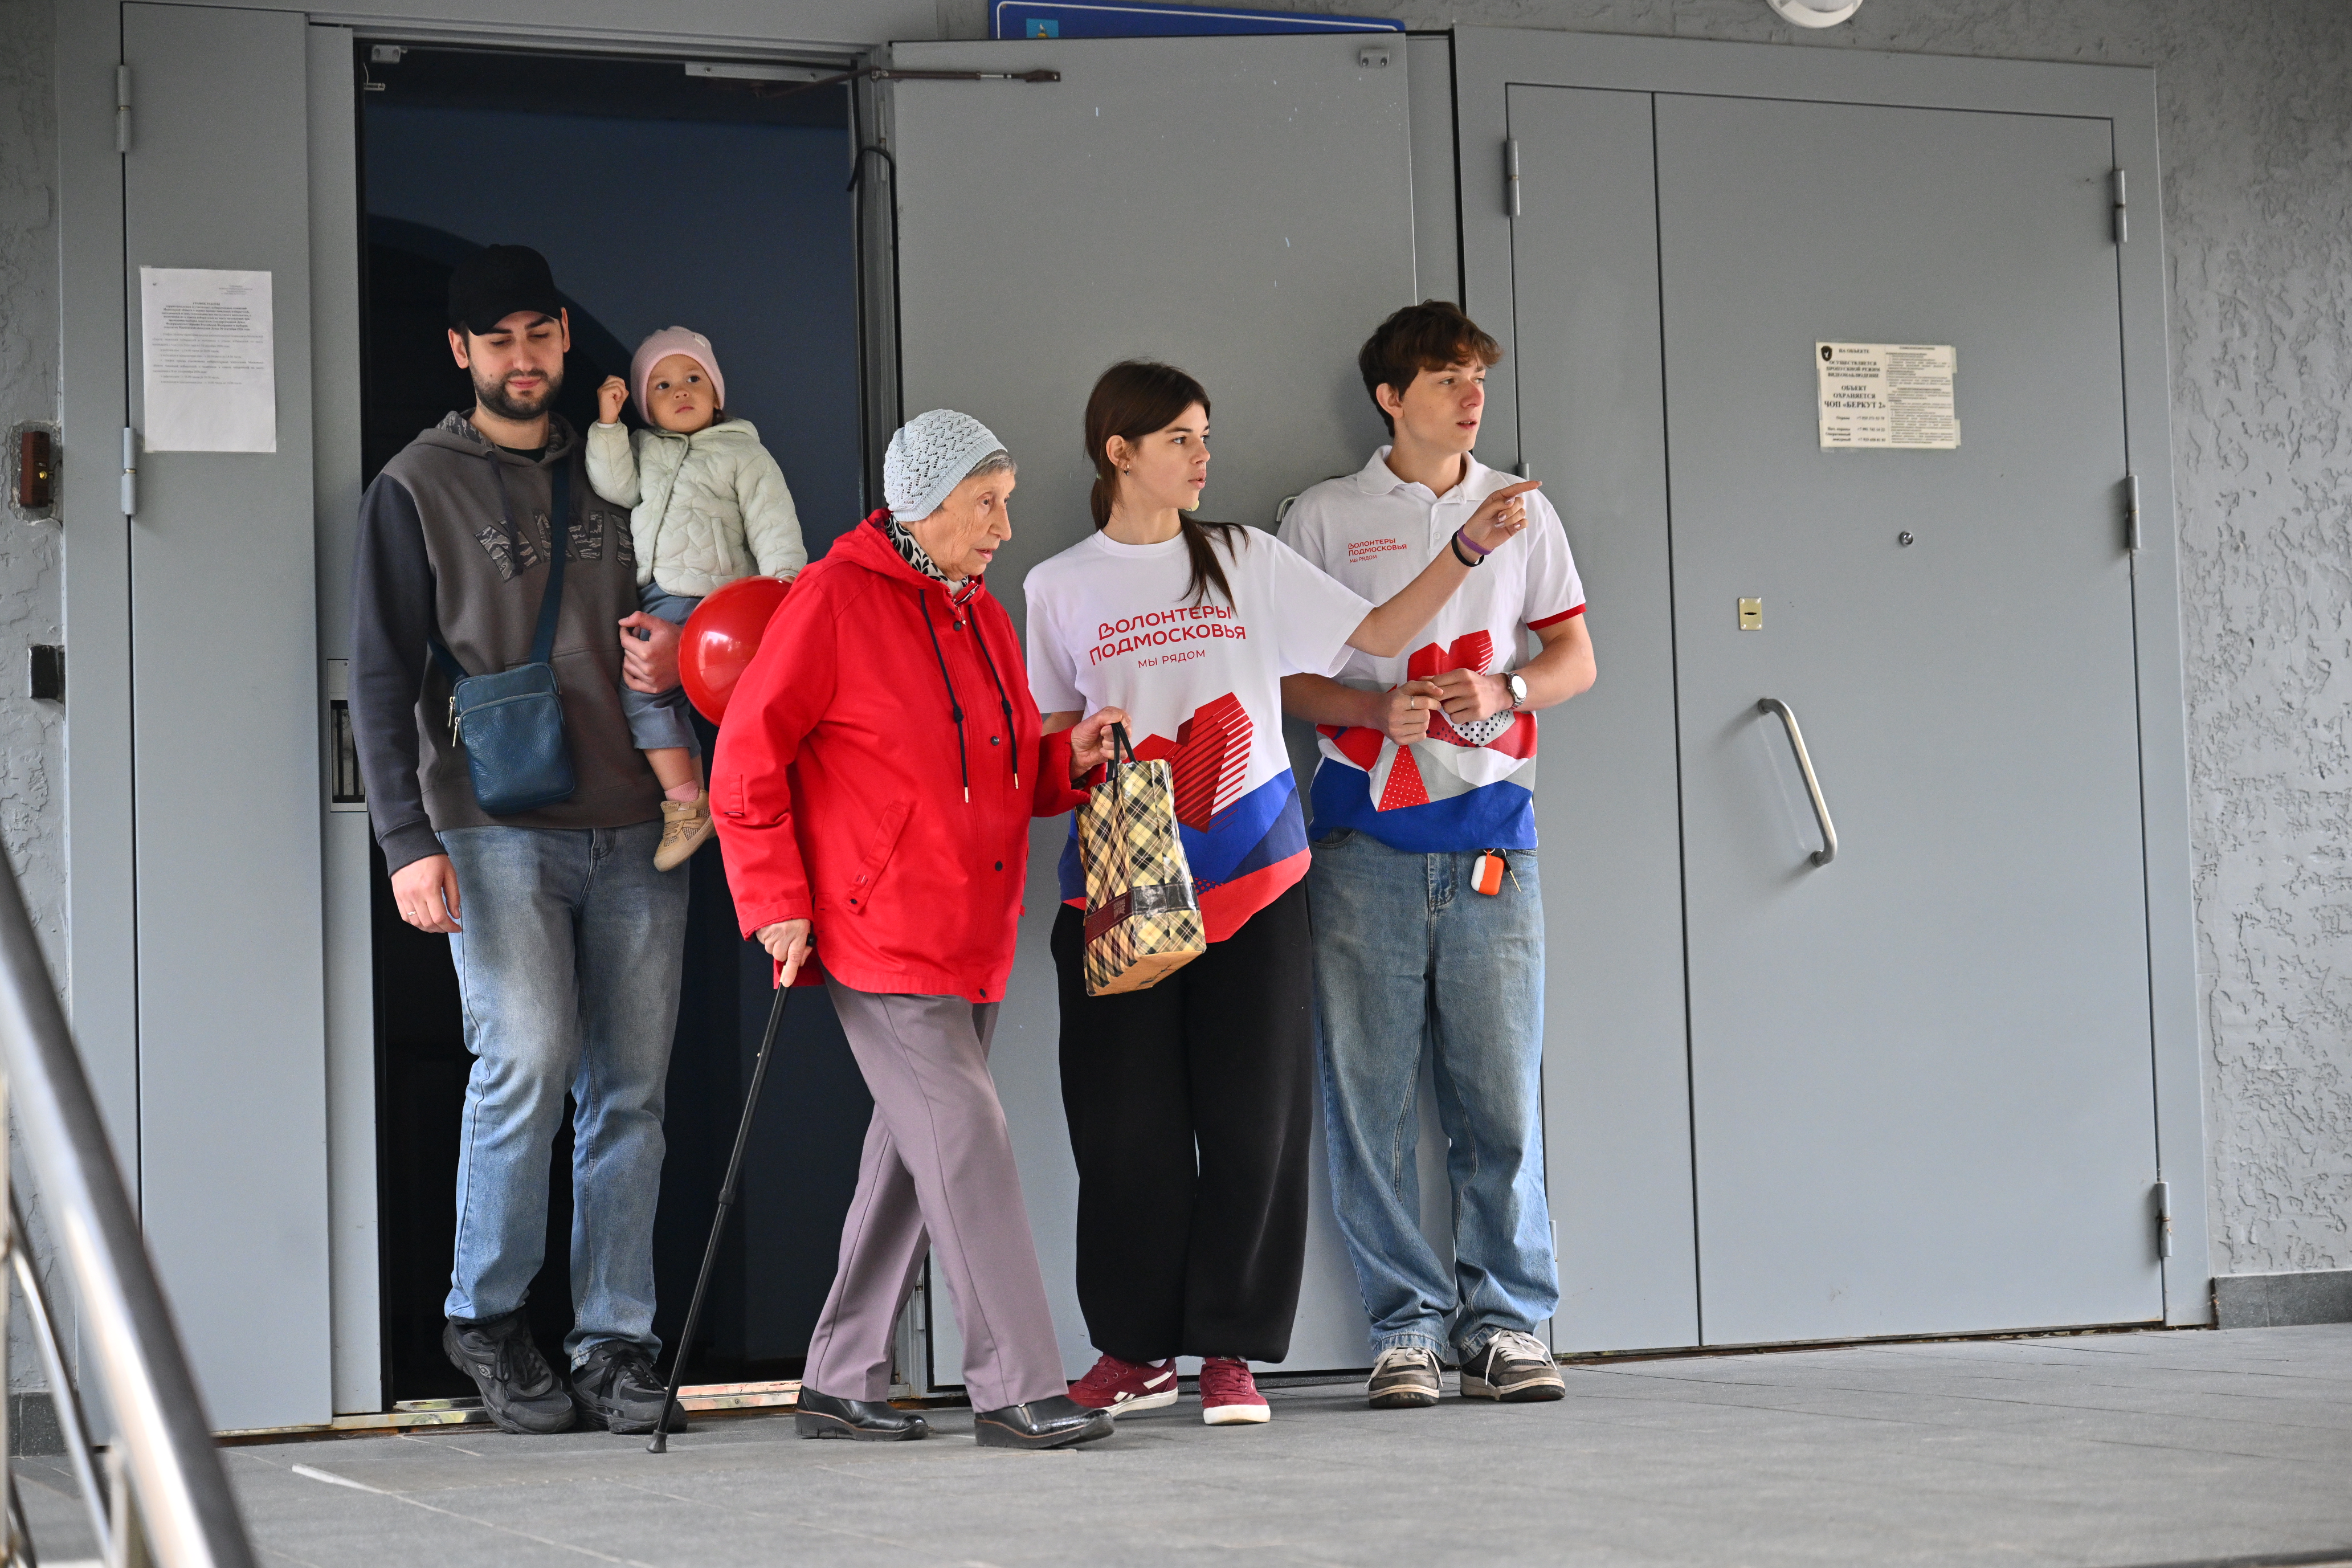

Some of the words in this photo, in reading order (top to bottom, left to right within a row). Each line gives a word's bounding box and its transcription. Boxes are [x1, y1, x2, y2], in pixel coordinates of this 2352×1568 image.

[1348, 538, 1396, 550] ВОЛОНТЕРЫ
[1348, 544, 1407, 557] ПОДМОСКОВЬЯ
[1099, 605, 1231, 641] ВОЛОНТЕРЫ
[1089, 623, 1246, 666] ПОДМОСКОВЬЯ
[1138, 657, 1158, 668] МЫ
[1162, 650, 1206, 664] РЯДОМ
